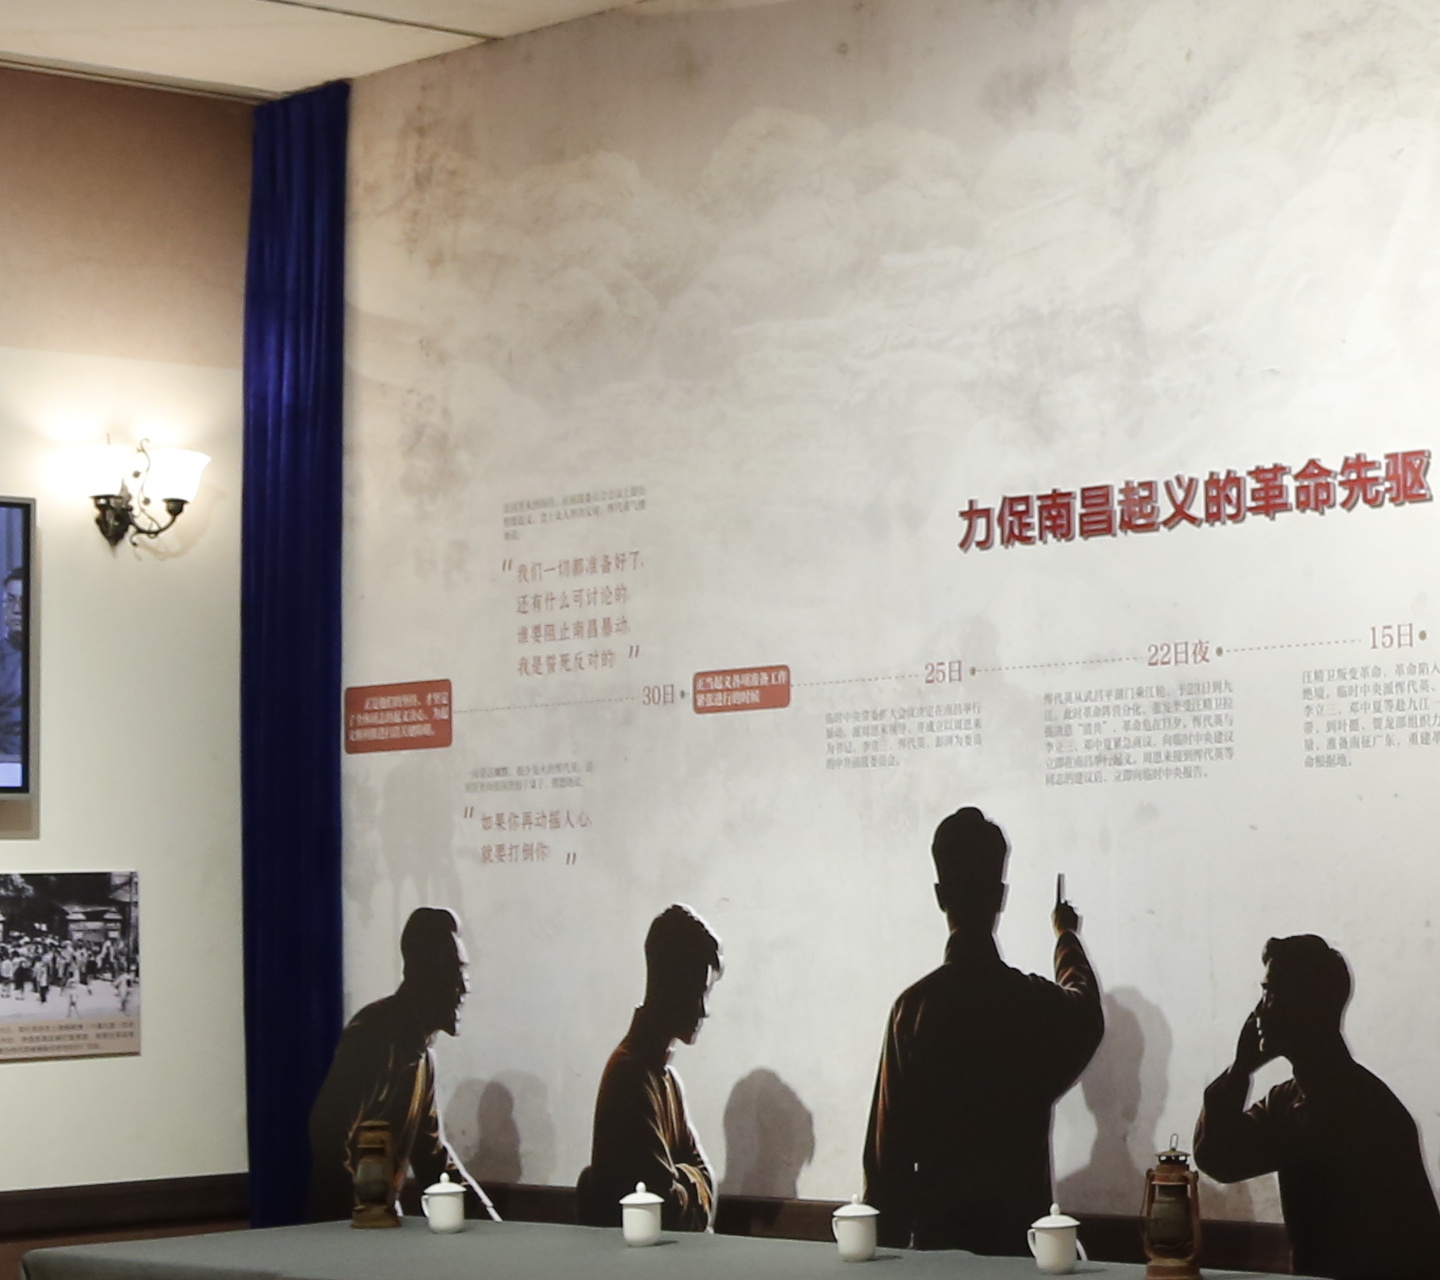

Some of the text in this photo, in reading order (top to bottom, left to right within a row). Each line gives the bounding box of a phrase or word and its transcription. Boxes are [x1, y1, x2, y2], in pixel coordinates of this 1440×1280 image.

[957, 449, 1433, 552] 力促南昌起义的革命先驱
[1369, 622, 1414, 650] 15日
[1146, 639, 1211, 667] 22日夜
[924, 659, 963, 684] 25日
[641, 683, 675, 706] 30日
